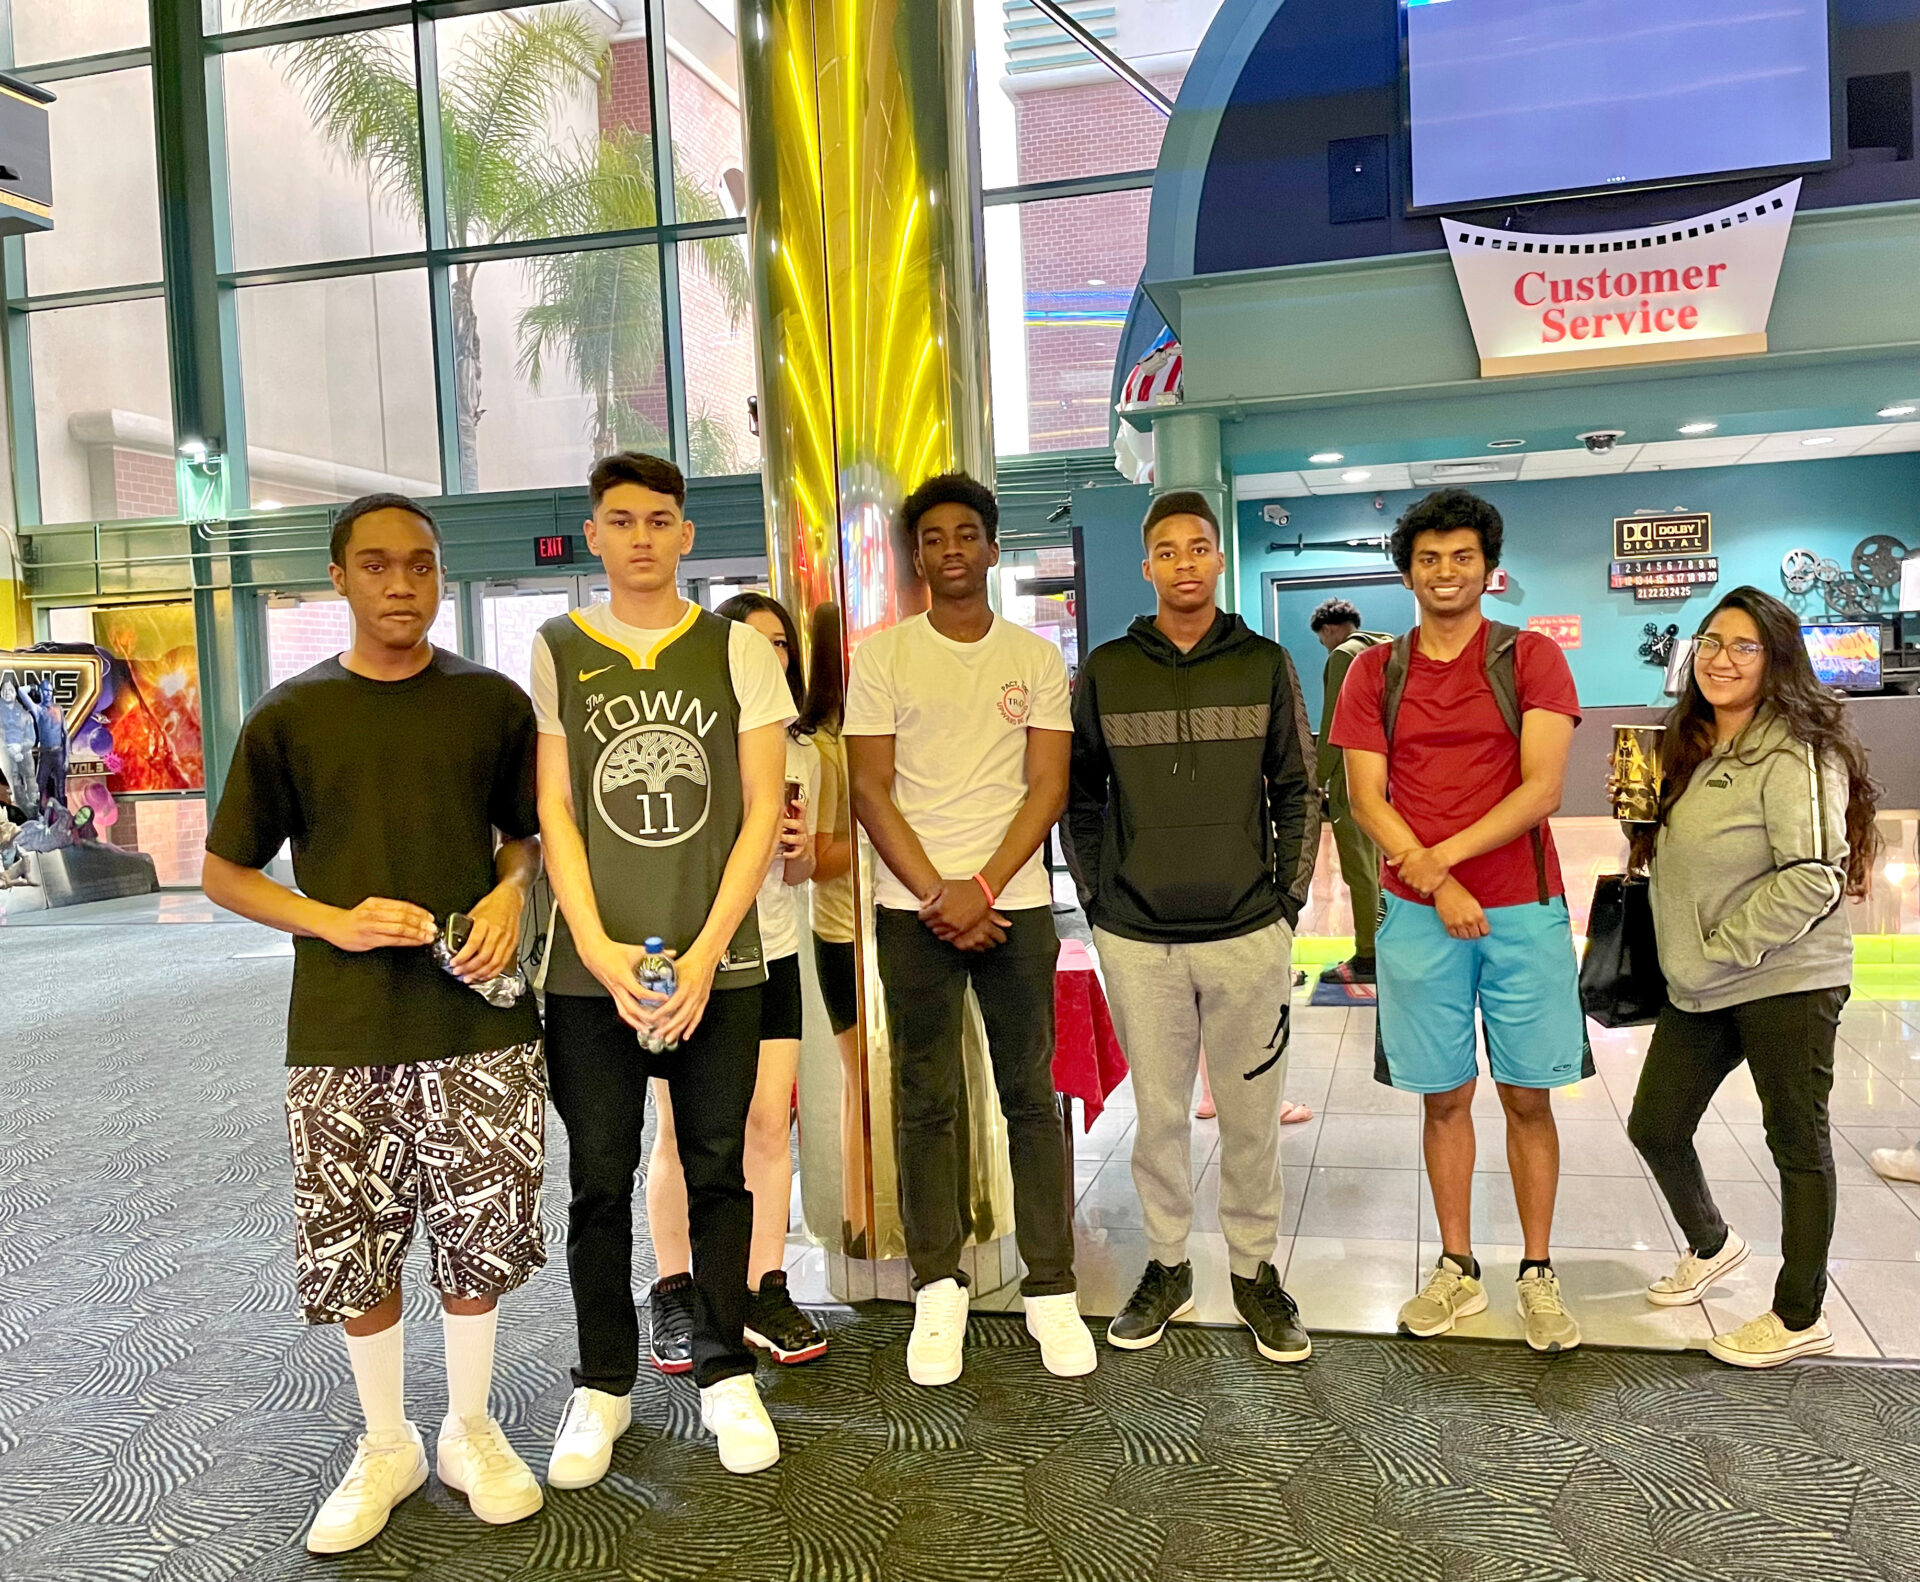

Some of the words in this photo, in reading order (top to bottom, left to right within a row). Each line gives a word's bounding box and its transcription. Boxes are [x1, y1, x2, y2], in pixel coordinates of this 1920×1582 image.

[1514, 263, 1727, 307] Customer
[1541, 300, 1699, 345] Service
[1658, 524, 1695, 536] DOLBY
[539, 536, 563, 558] EXIT
[1623, 538, 1702, 551] DIGITAL
[1707, 559, 1717, 569] 10
[1645, 575, 1654, 585] 14
[1655, 575, 1664, 584] 15
[1666, 574, 1674, 584] 16
[1676, 573, 1685, 583] 17
[1687, 573, 1695, 583] 18
[1697, 572, 1706, 582] 19
[1707, 571, 1718, 581] 20
[1638, 589, 1647, 598] 21
[1648, 588, 1658, 598] 22
[1659, 588, 1668, 597] 23
[1670, 587, 1680, 596] 24
[1680, 586, 1691, 596] 25
[586, 692, 605, 712] The
[583, 690, 718, 744] TOWN
[70, 763, 95, 774] VOL
[636, 792, 680, 835] 11
